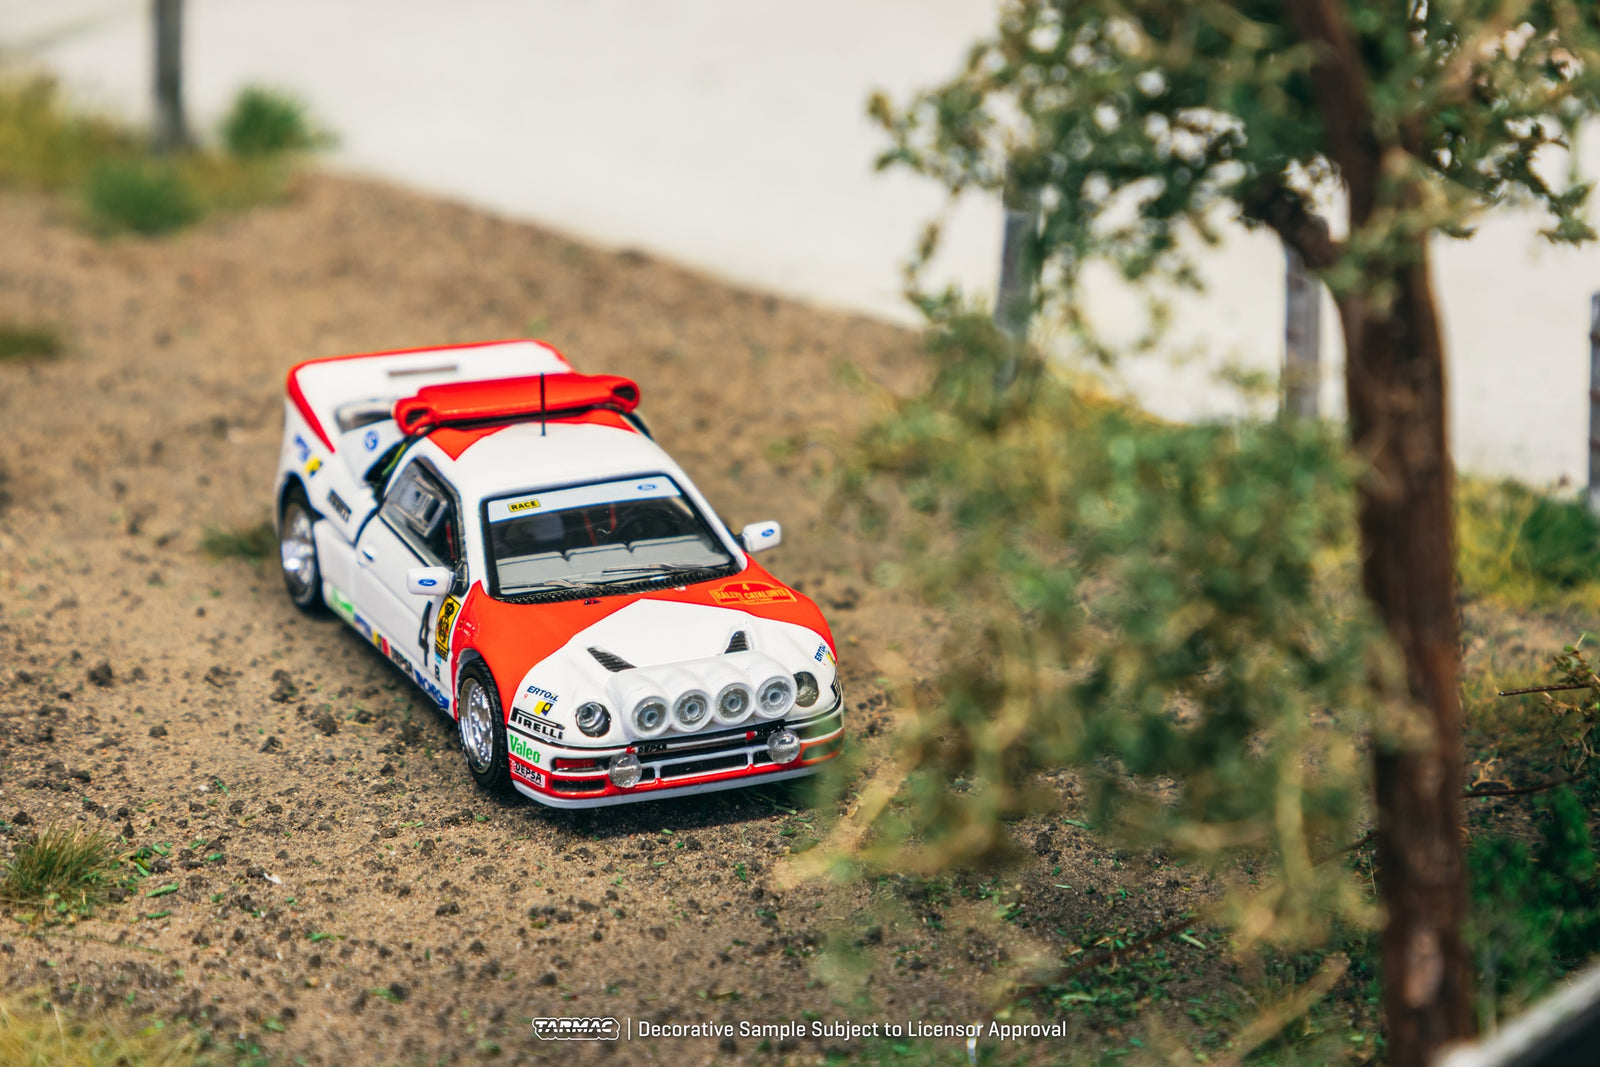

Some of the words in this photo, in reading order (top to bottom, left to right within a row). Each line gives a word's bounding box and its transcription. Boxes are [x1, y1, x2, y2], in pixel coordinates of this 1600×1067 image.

[510, 500, 538, 510] RACE
[419, 600, 432, 668] 4
[510, 707, 565, 740] PIRELLI
[509, 734, 540, 764] Valeo
